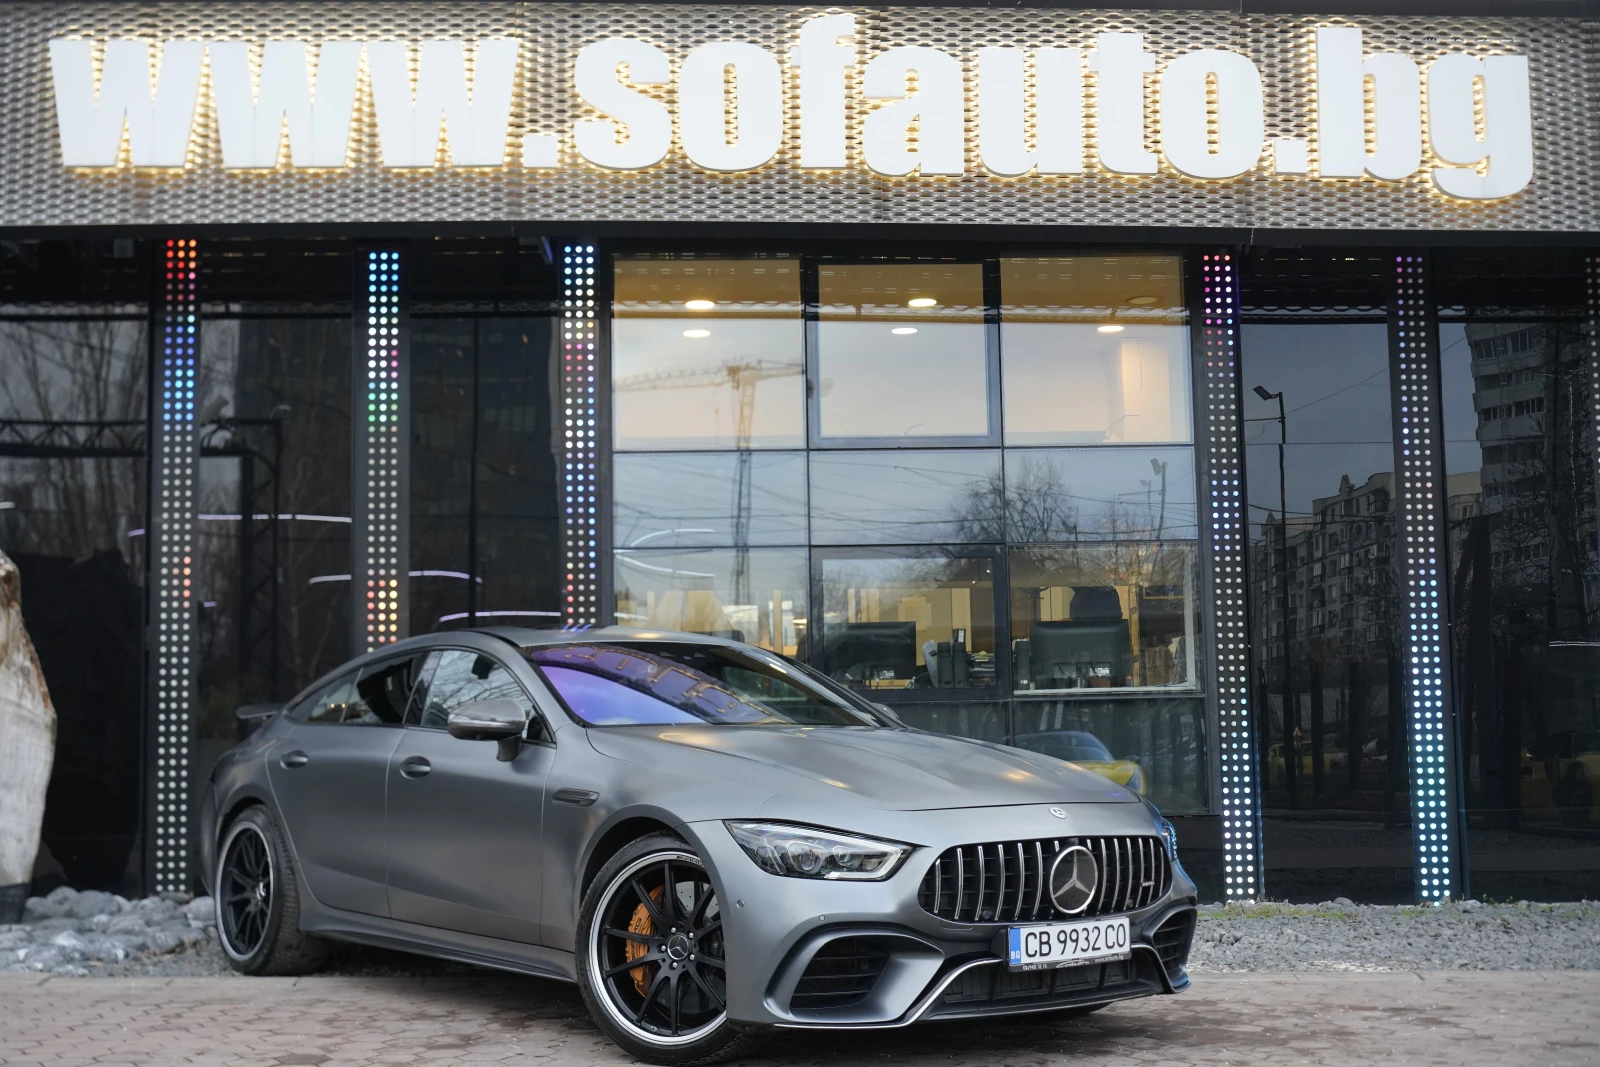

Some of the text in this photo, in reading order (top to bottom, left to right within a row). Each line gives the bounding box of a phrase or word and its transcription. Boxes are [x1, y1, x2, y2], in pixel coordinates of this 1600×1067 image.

[48, 14, 1533, 199] www.sofauto.bg
[1010, 950, 1021, 959] BG
[1025, 923, 1126, 957] CB 9932 CO
